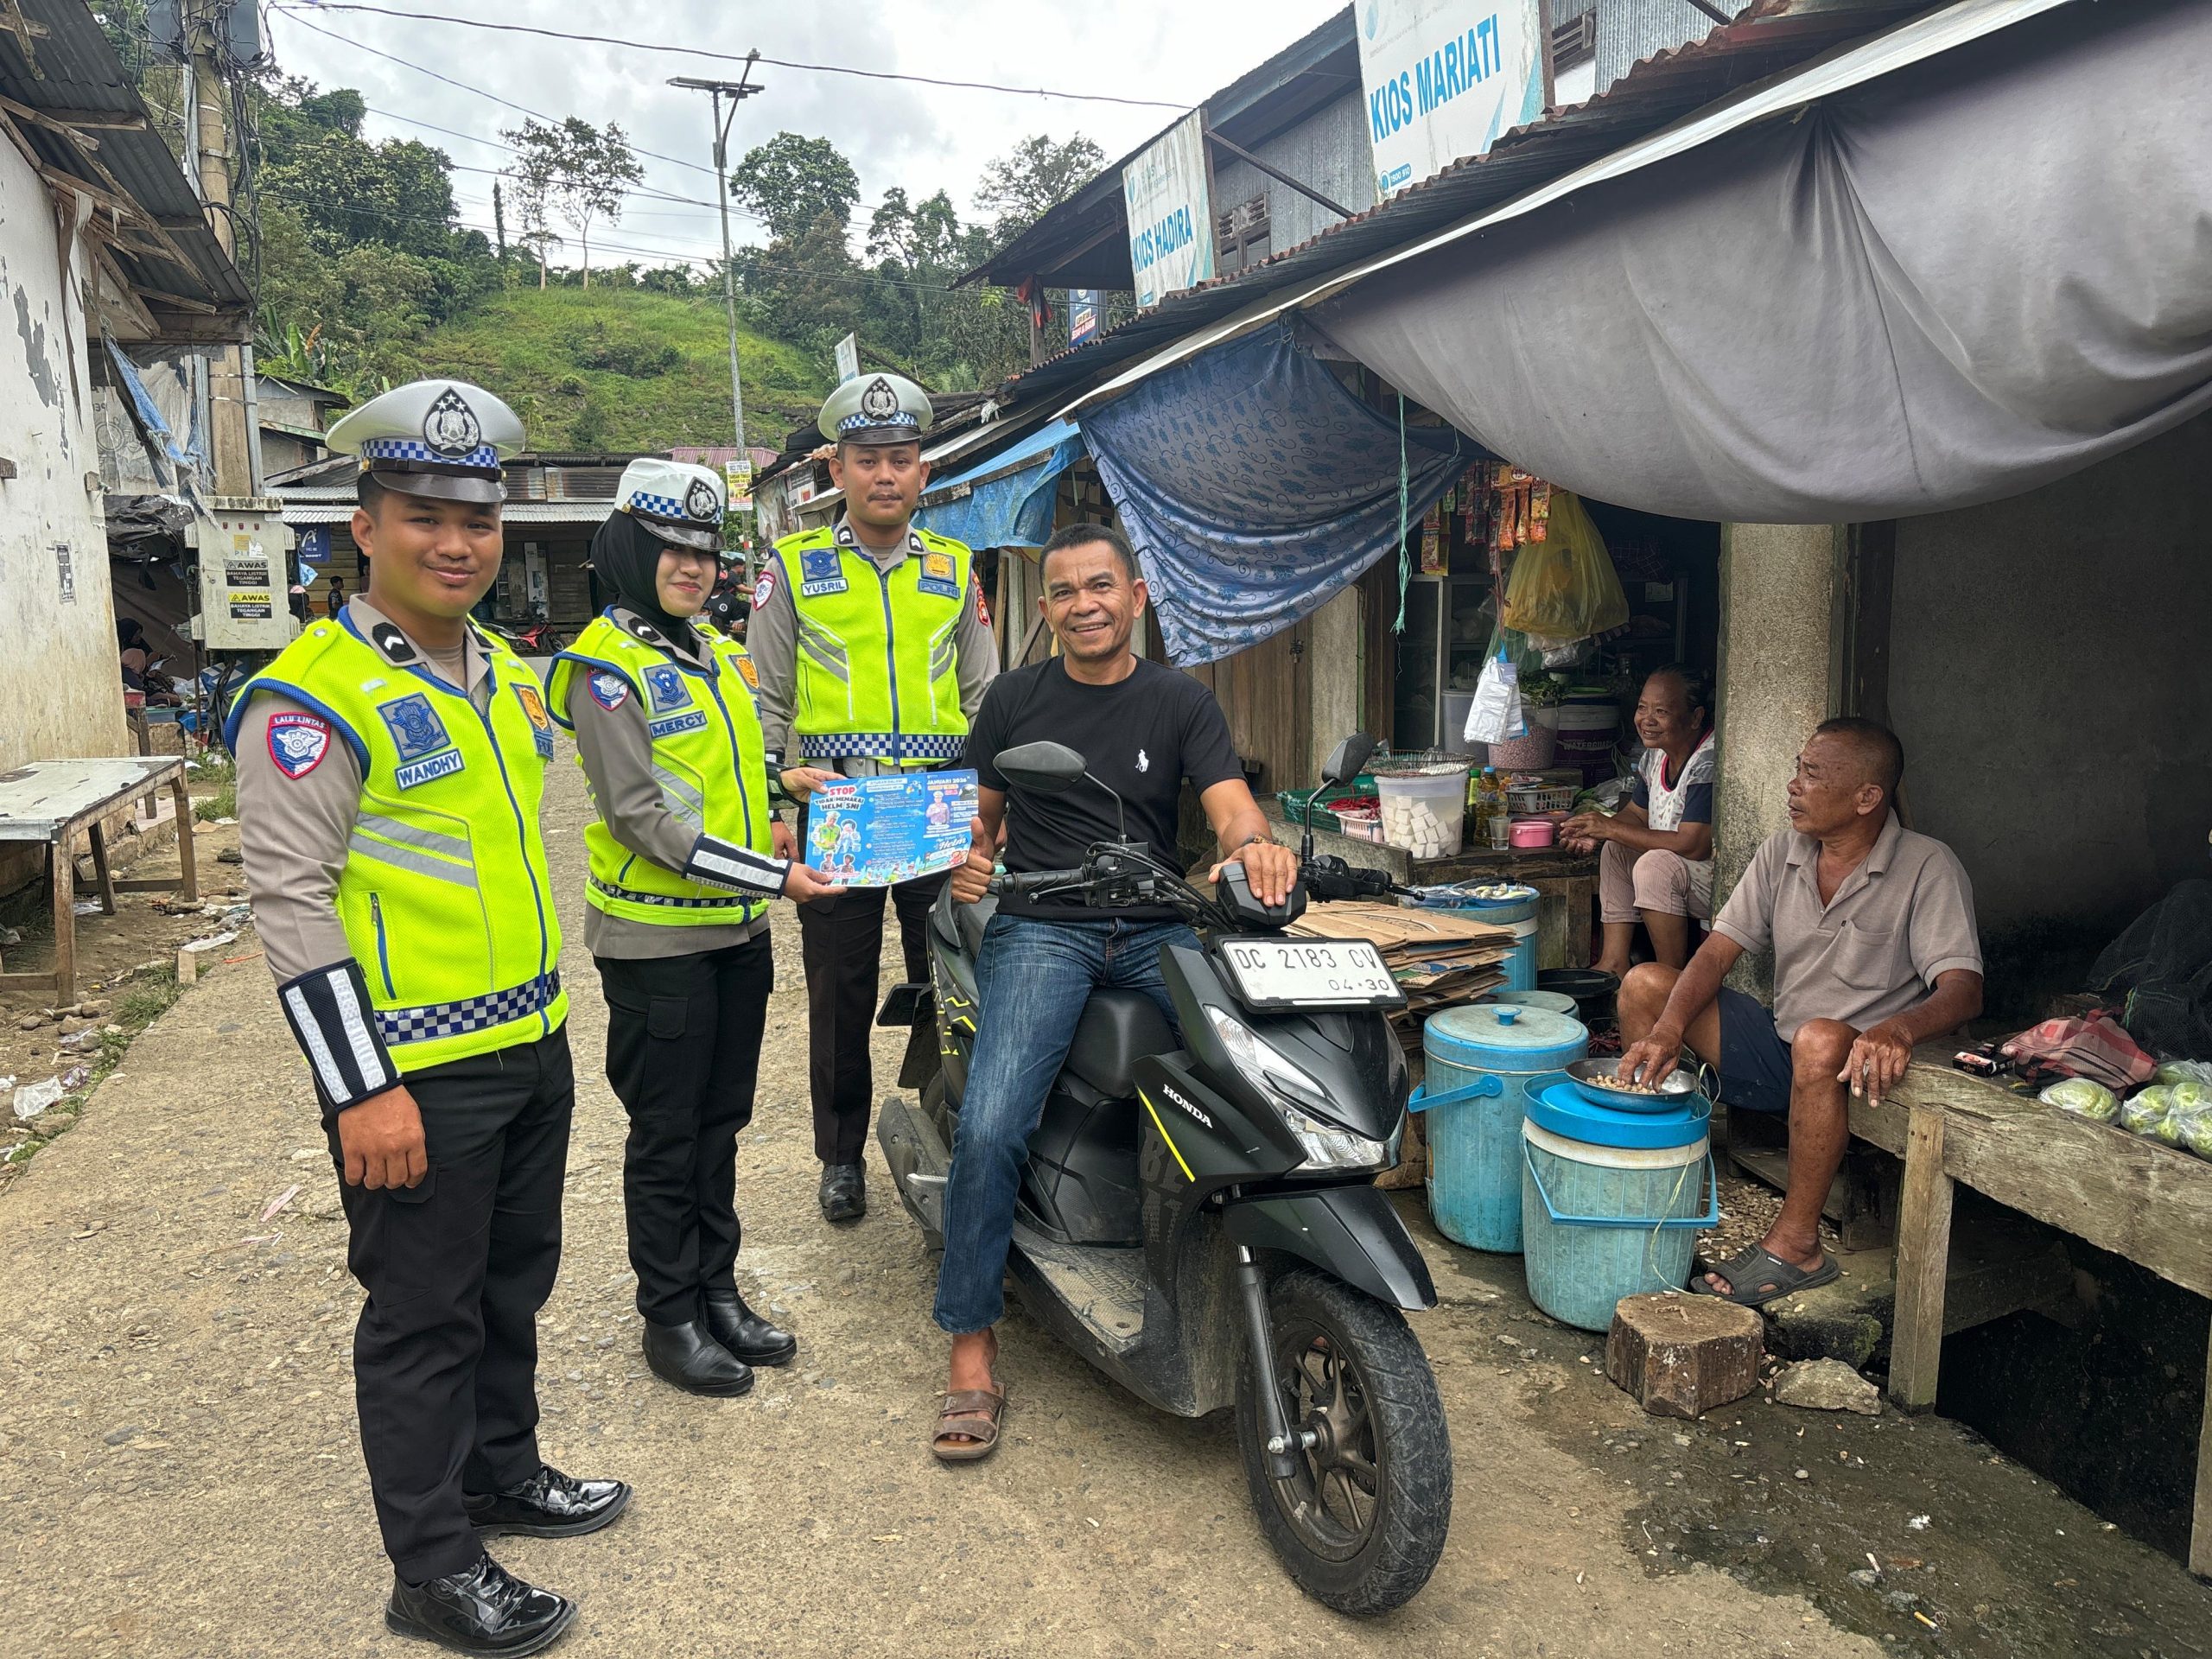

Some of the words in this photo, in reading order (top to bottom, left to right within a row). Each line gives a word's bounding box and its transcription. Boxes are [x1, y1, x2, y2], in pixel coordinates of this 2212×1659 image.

[1370, 71, 1413, 143] KIOS
[1415, 13, 1501, 117] MARIATI
[1132, 228, 1154, 274] KIOS
[1154, 204, 1193, 261] HADIRA
[804, 582, 845, 594] YUSRIL
[921, 582, 958, 596] POLRI
[274, 715, 295, 724] LALU
[297, 715, 326, 728] LINTAS
[652, 714, 702, 735] MERCY
[398, 753, 457, 785] WANDHY
[829, 786, 855, 796] STOP
[939, 837, 967, 849] Helm
[1233, 949, 1266, 969] DC
[1277, 948, 1337, 969] 2183
[1162, 1084, 1213, 1129] HONDA
